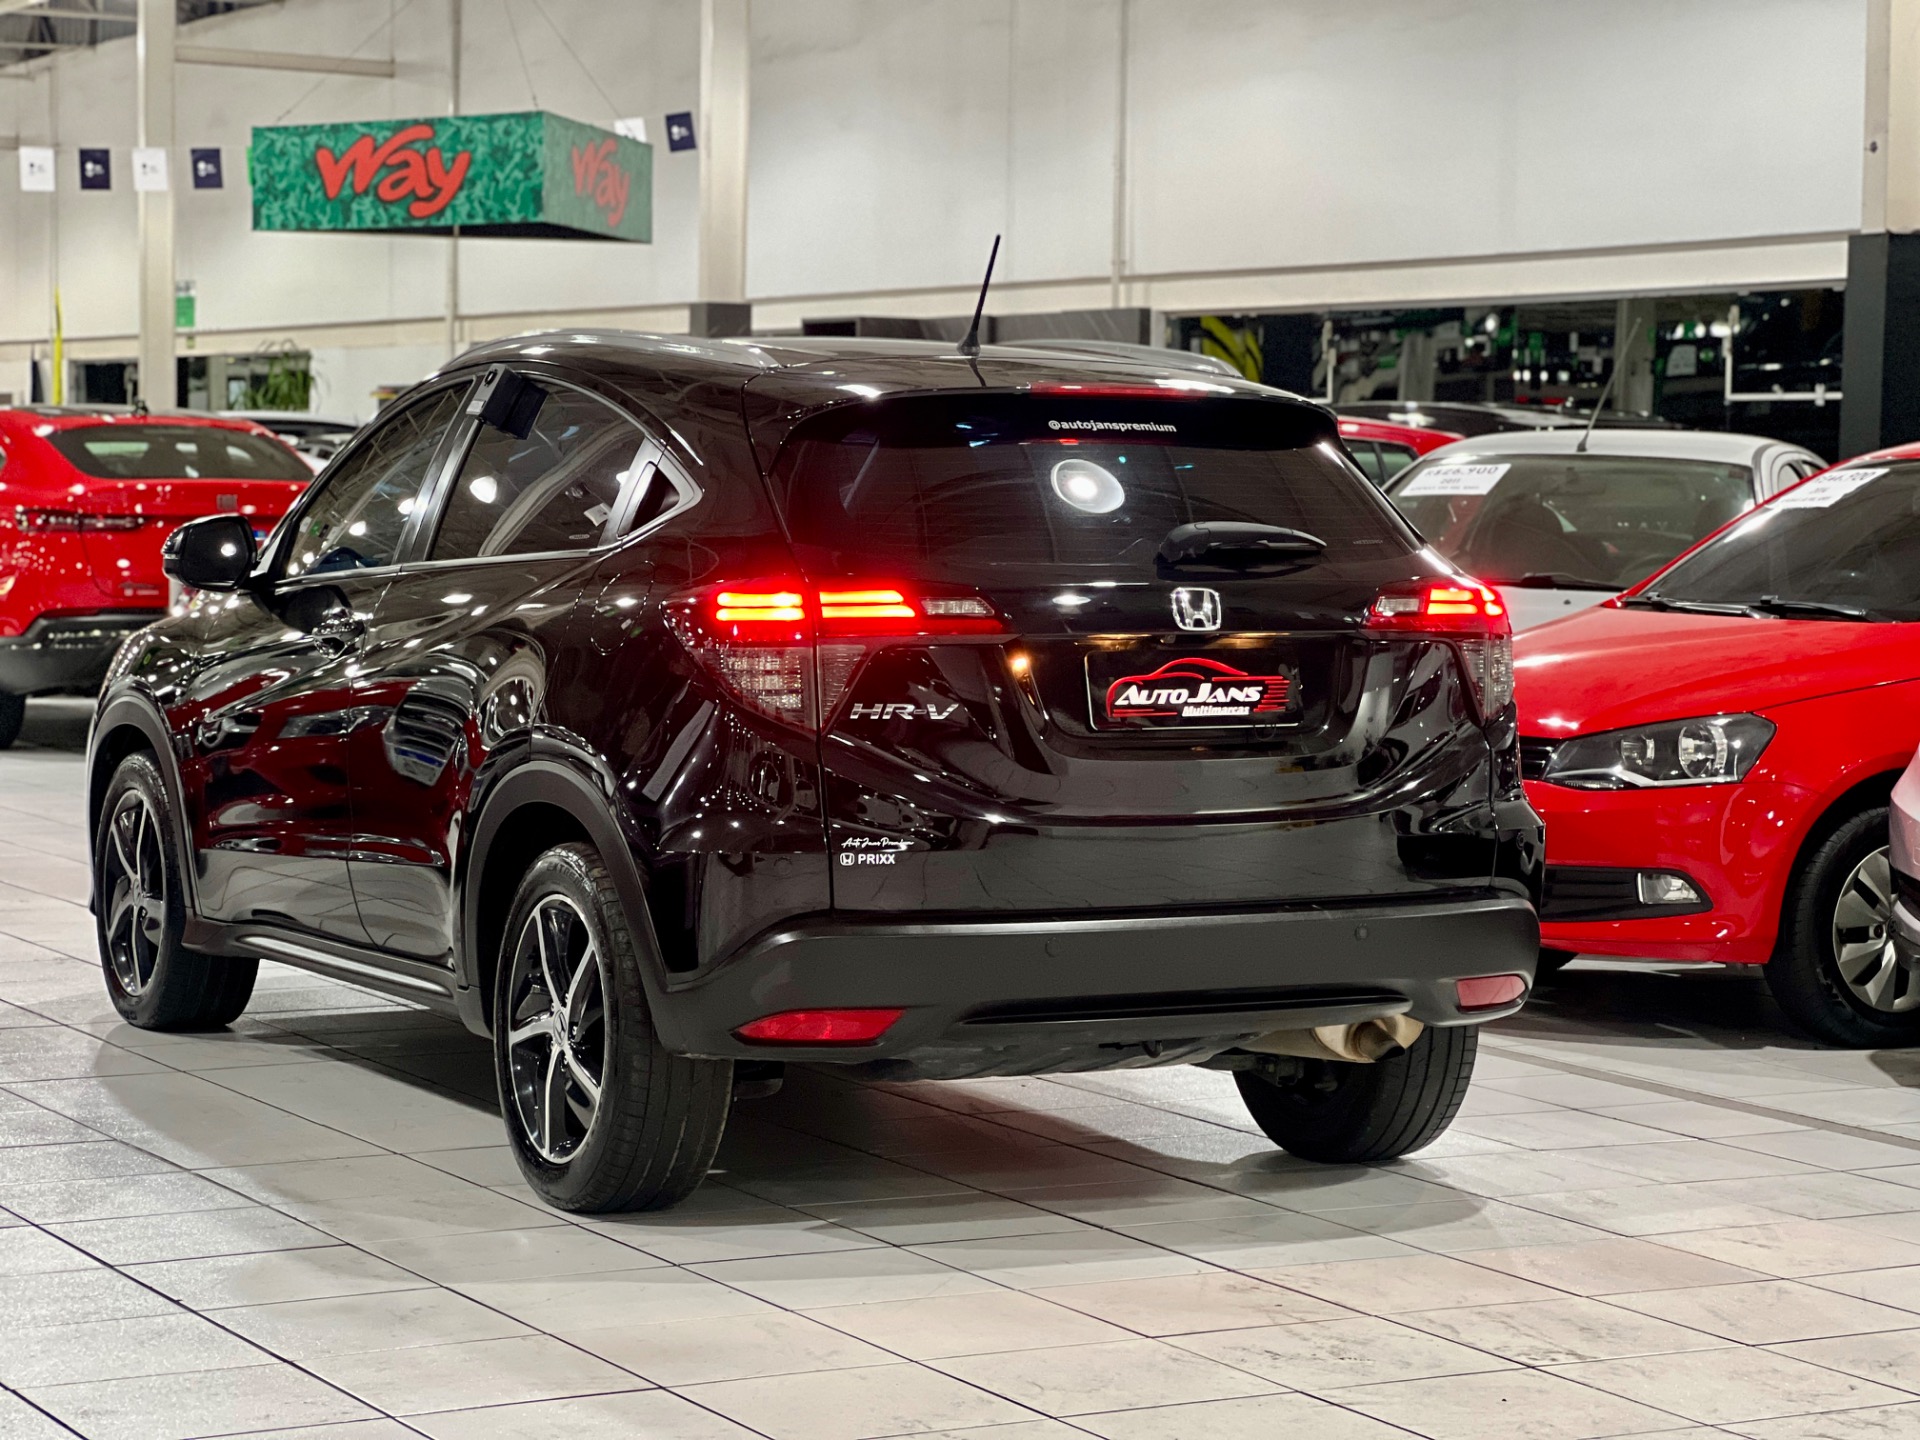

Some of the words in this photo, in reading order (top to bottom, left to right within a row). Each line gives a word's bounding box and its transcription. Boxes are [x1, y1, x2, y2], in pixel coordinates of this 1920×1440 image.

[315, 124, 472, 219] Way
[571, 138, 631, 228] Way
[1048, 420, 1177, 432] @autojanspremium
[850, 703, 960, 720] HR-V
[1181, 705, 1250, 717] Multimarcas
[858, 853, 896, 865] PRIXX
